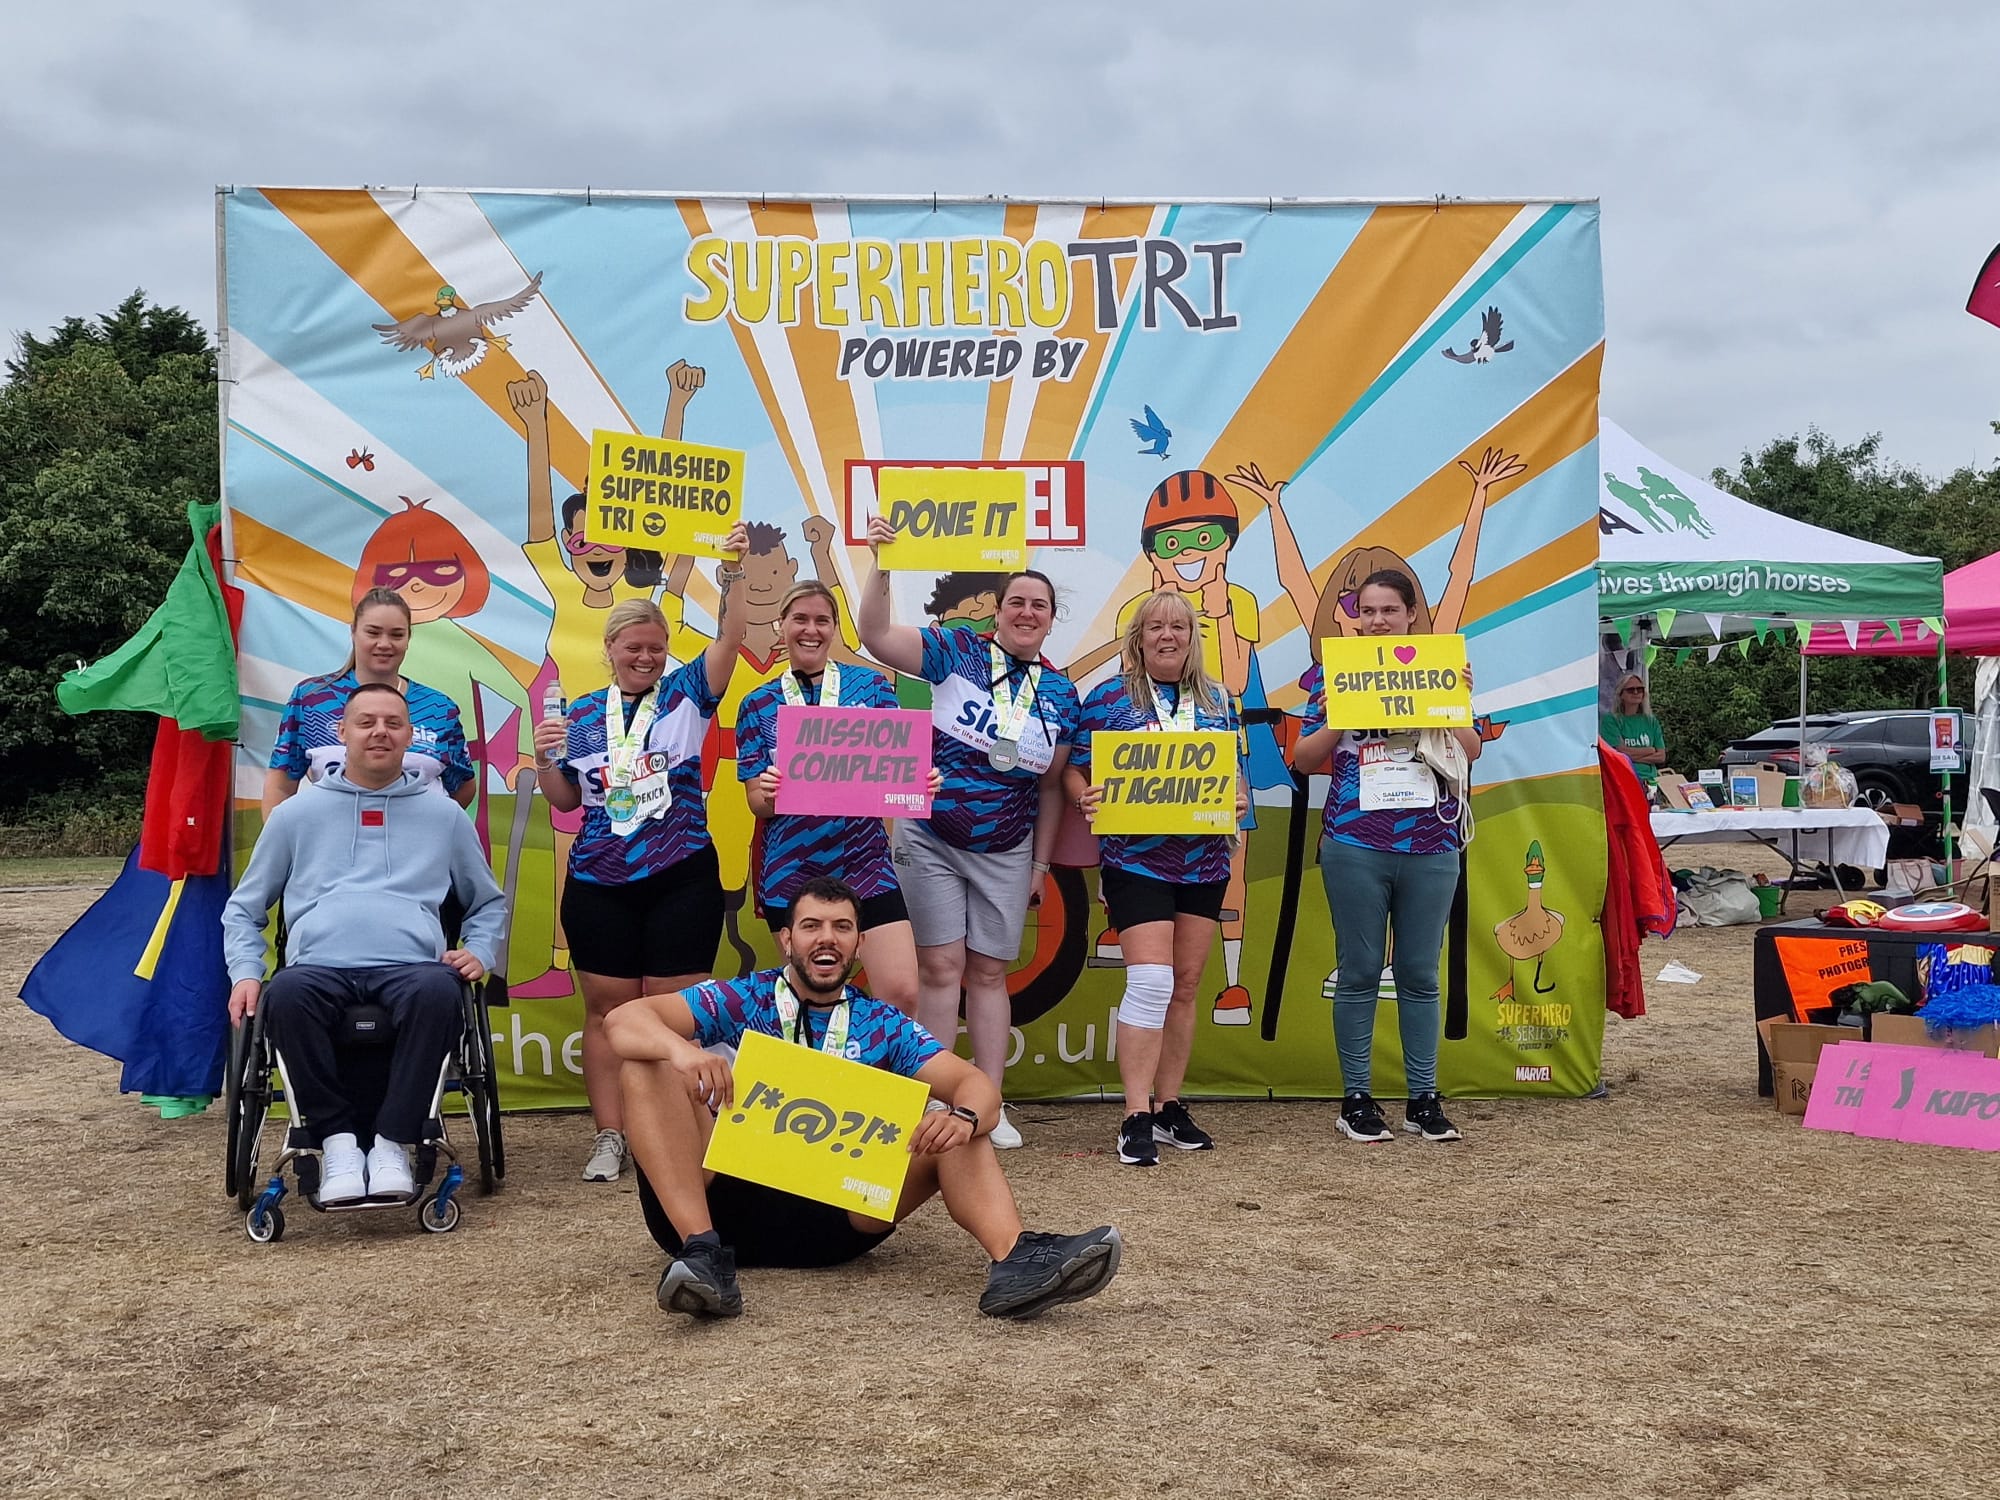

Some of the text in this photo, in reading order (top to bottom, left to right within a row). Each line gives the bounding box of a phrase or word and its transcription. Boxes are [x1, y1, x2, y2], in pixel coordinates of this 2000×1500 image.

[841, 338, 1085, 380] POWERED BY
[603, 443, 731, 484] I SMASHED
[600, 474, 731, 516] SUPERHERO
[852, 466, 1079, 540] MEL
[598, 505, 634, 533] TRI
[889, 498, 1018, 539] DONE IT
[1598, 566, 1852, 598] ives through horses
[1377, 646, 1384, 666] I
[1334, 668, 1457, 694] SUPERHERO
[1380, 695, 1415, 717] TRI
[795, 718, 913, 749] MISSION
[788, 751, 918, 785] COMPLETE
[1112, 741, 1216, 771] CAN I DO
[1100, 775, 1231, 805] IT AGAIN?!
[1818, 956, 1869, 980] PHOTOGR
[1497, 1003, 1572, 1026] SUPERHERO
[1516, 1025, 1553, 1042] SERIES
[1515, 1066, 1551, 1081] MARVEL
